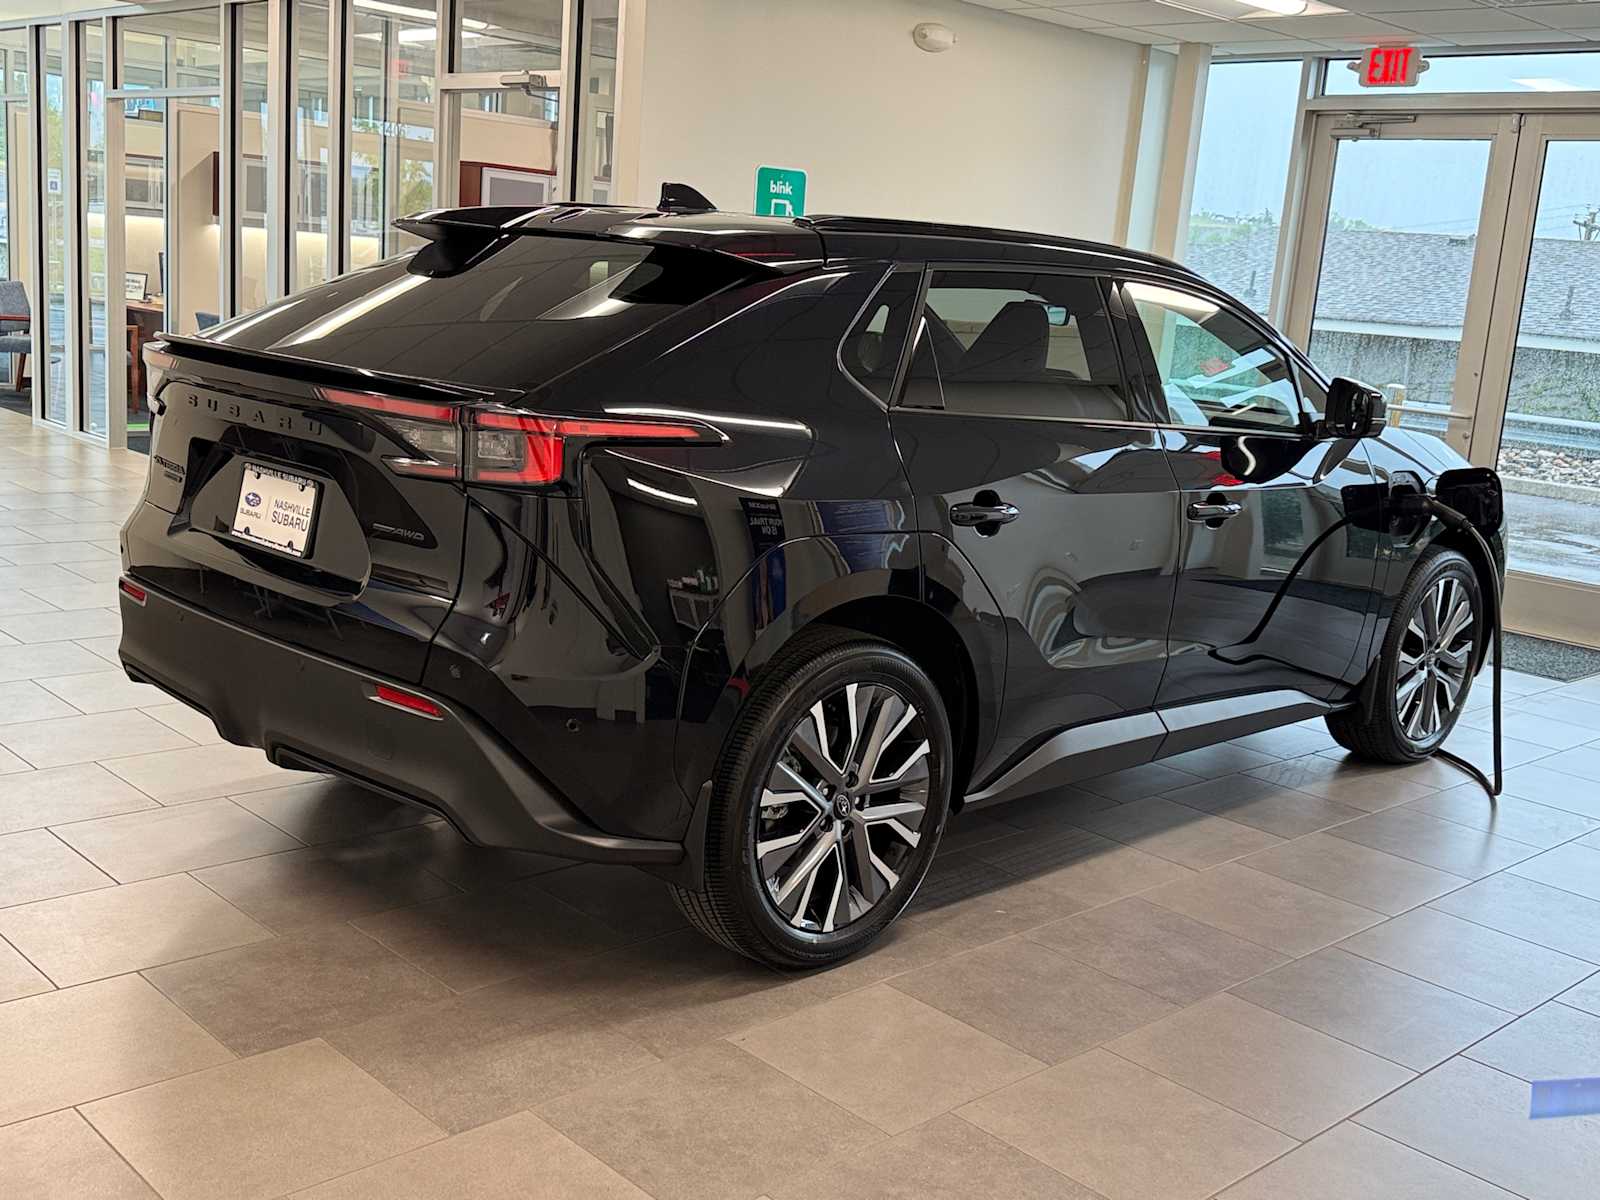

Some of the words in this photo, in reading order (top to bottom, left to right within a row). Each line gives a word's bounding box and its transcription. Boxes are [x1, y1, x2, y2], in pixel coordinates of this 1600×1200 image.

[1368, 47, 1413, 84] EXIT
[769, 179, 793, 195] blink
[188, 394, 322, 435] SUBARU
[273, 499, 312, 518] NASHVILLE
[271, 510, 309, 532] SUBARU
